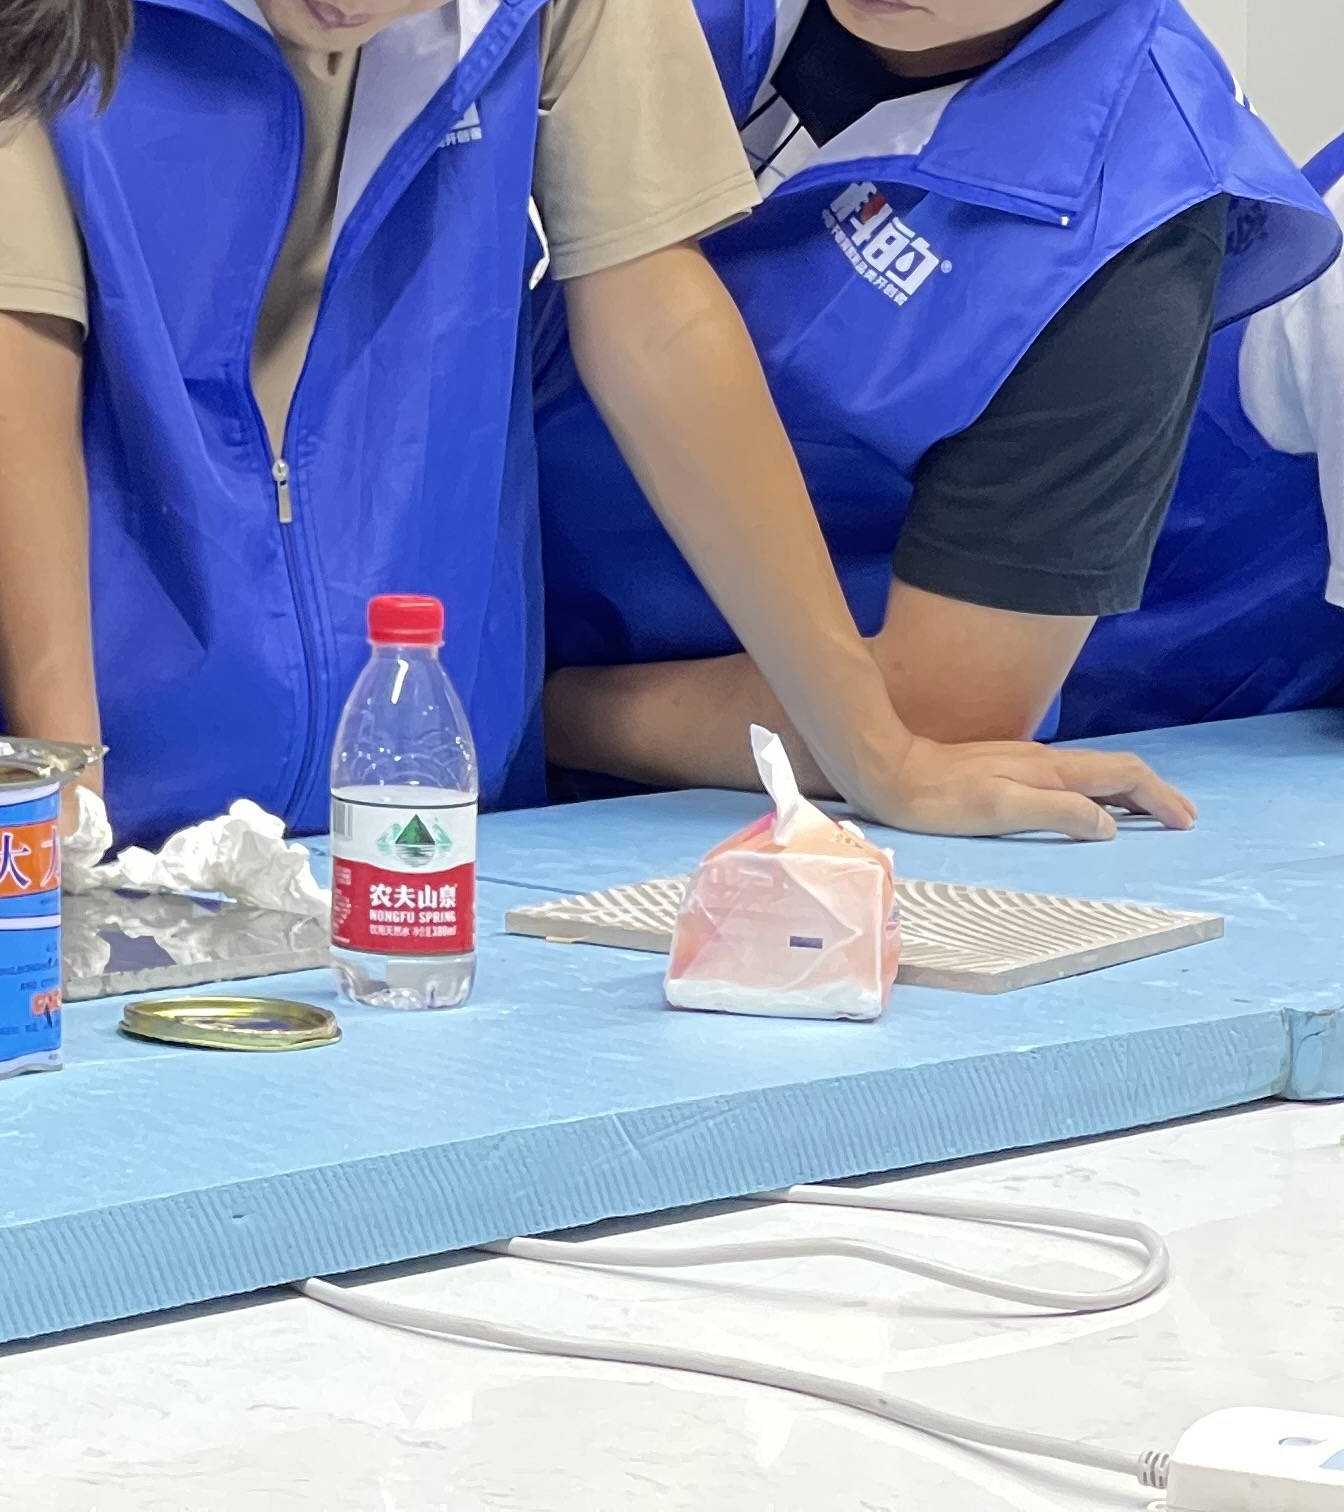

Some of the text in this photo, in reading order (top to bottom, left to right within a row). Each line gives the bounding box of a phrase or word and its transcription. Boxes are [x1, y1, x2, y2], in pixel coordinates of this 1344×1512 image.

[369, 883, 456, 909] 农夫山泉
[369, 909, 456, 923] NONGFU SPRING
